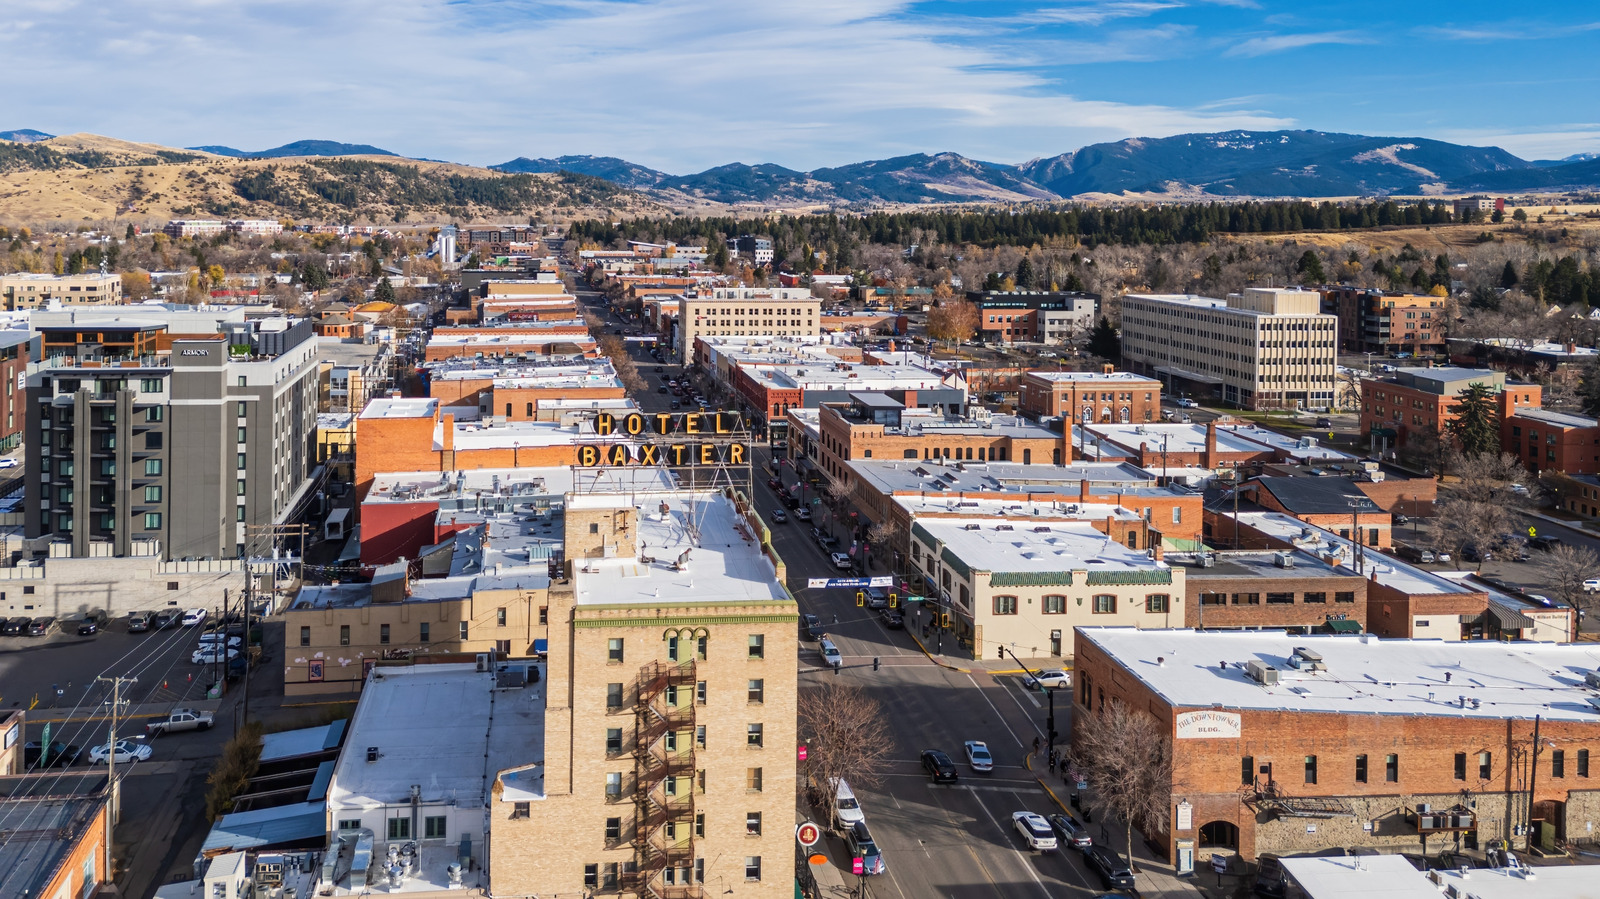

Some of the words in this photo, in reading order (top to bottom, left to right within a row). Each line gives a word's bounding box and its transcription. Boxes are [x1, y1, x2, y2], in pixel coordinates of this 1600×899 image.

[598, 413, 730, 436] HOTEL
[582, 443, 744, 467] BAXTER
[1178, 718, 1191, 729] THE
